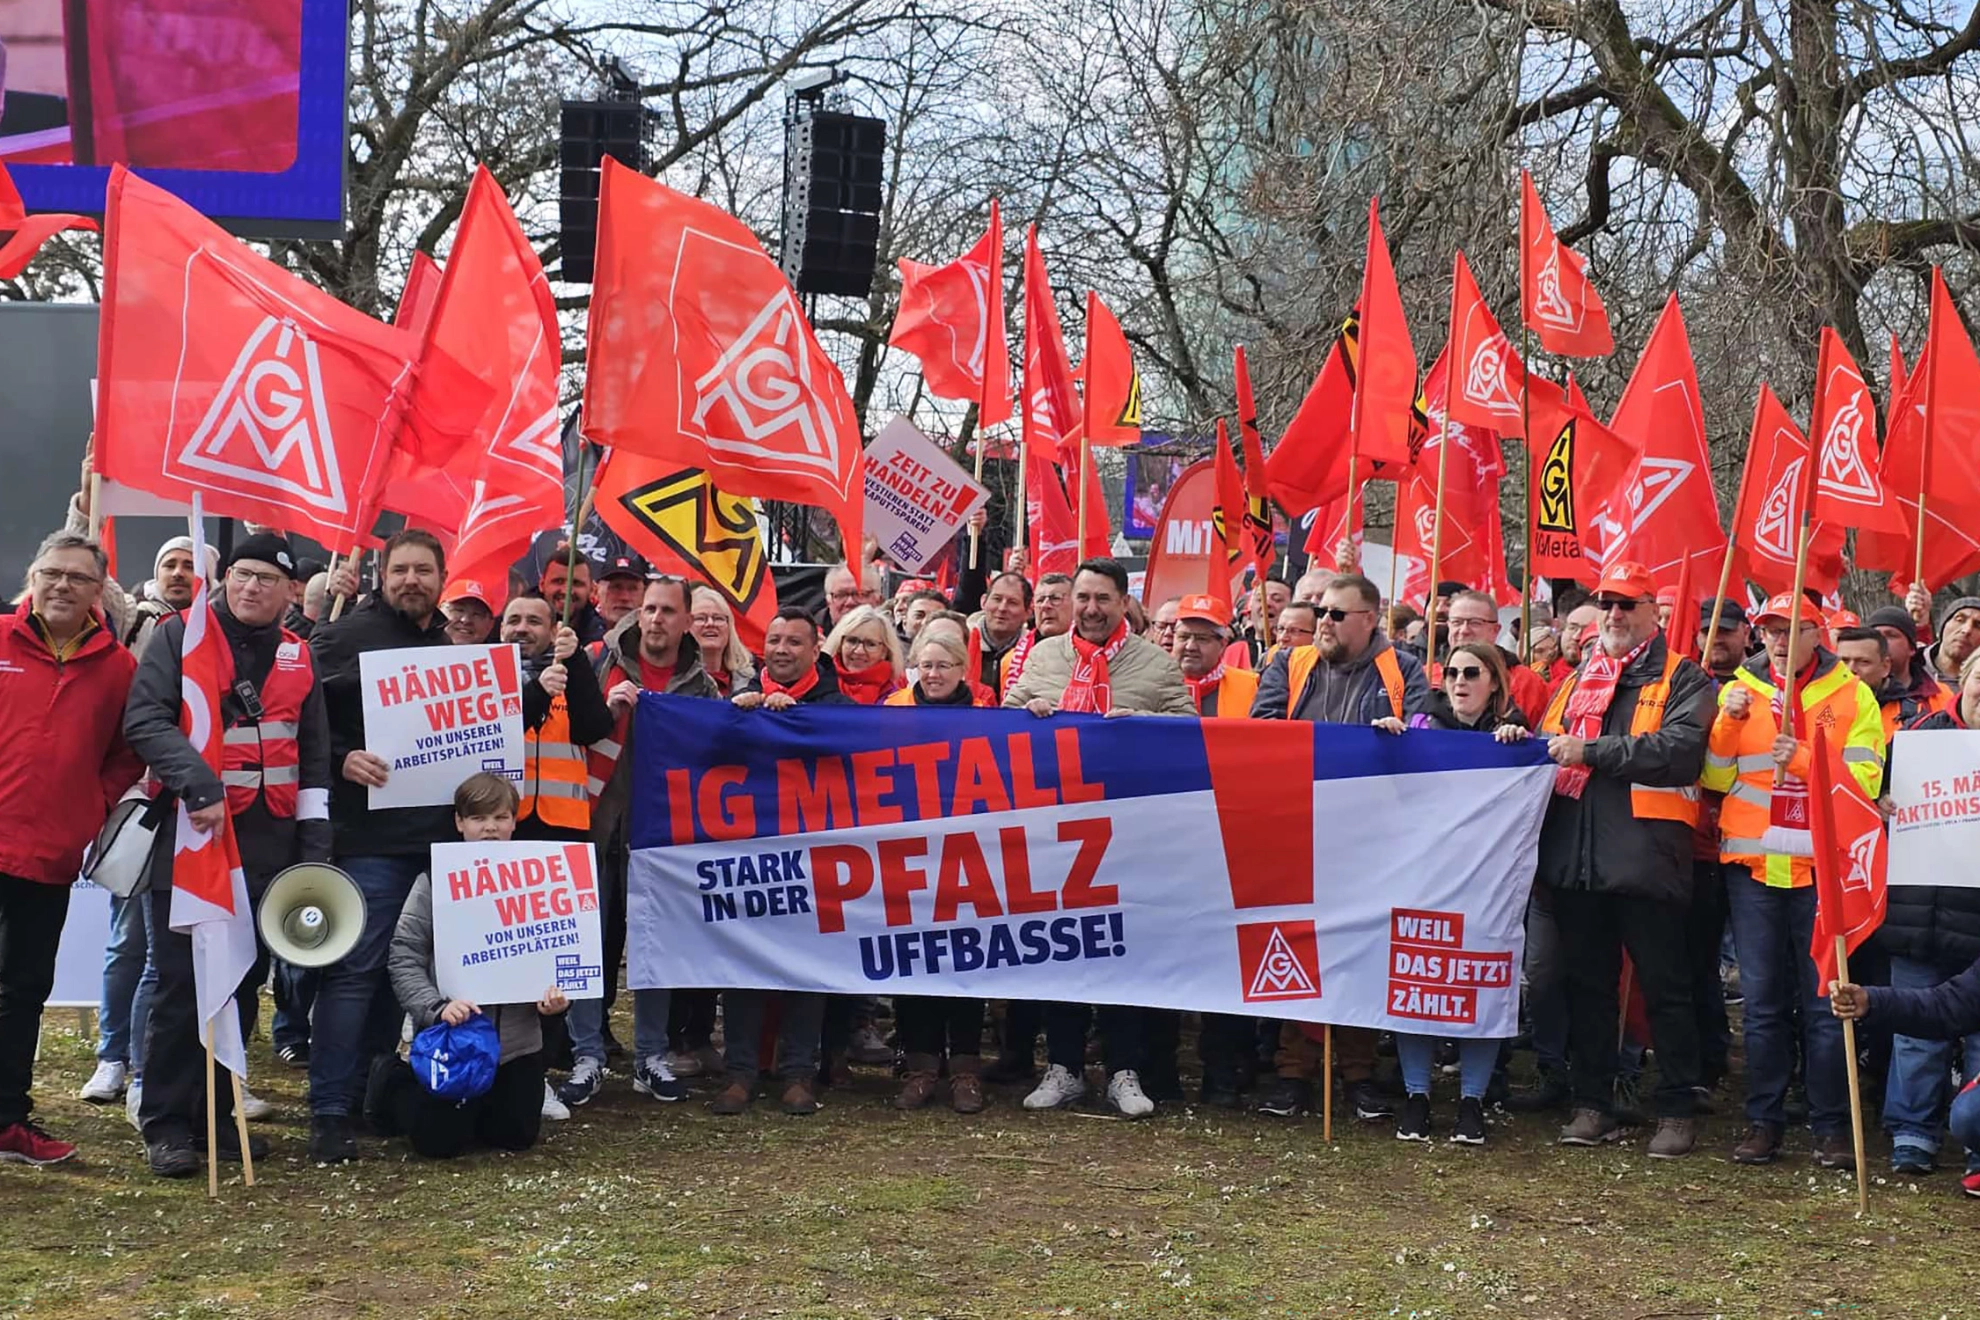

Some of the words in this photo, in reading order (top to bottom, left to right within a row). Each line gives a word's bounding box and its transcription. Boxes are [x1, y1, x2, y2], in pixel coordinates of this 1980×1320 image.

[864, 474, 909, 511] VESTIEREN
[889, 450, 932, 484] ZEIT
[930, 476, 958, 501] ZU
[377, 658, 493, 707] HÄNDE
[424, 692, 499, 732] WEG
[394, 737, 505, 771] ARBEITSPLÄTZEN!
[416, 734, 443, 750] VON
[445, 722, 502, 744] UNSEREN
[665, 764, 757, 846] IG
[776, 726, 1105, 836] METALL
[1922, 779, 1948, 799] 15.
[447, 854, 567, 901] HÄNDE
[696, 850, 806, 891] STARK
[808, 816, 1119, 934] PFALZ
[494, 887, 574, 927] WEG
[701, 892, 738, 923] IN
[743, 885, 812, 918] DER
[485, 929, 514, 946] VON
[516, 918, 577, 940] UNSEREN
[859, 911, 1126, 981] UFFBASSE!
[1396, 915, 1455, 942] WEIL
[462, 932, 581, 967] ARBEITSPLÄTZEN!
[1394, 952, 1442, 978] DAS
[1446, 958, 1511, 984] JETZT
[1391, 987, 1470, 1018] ZÄHLT.
